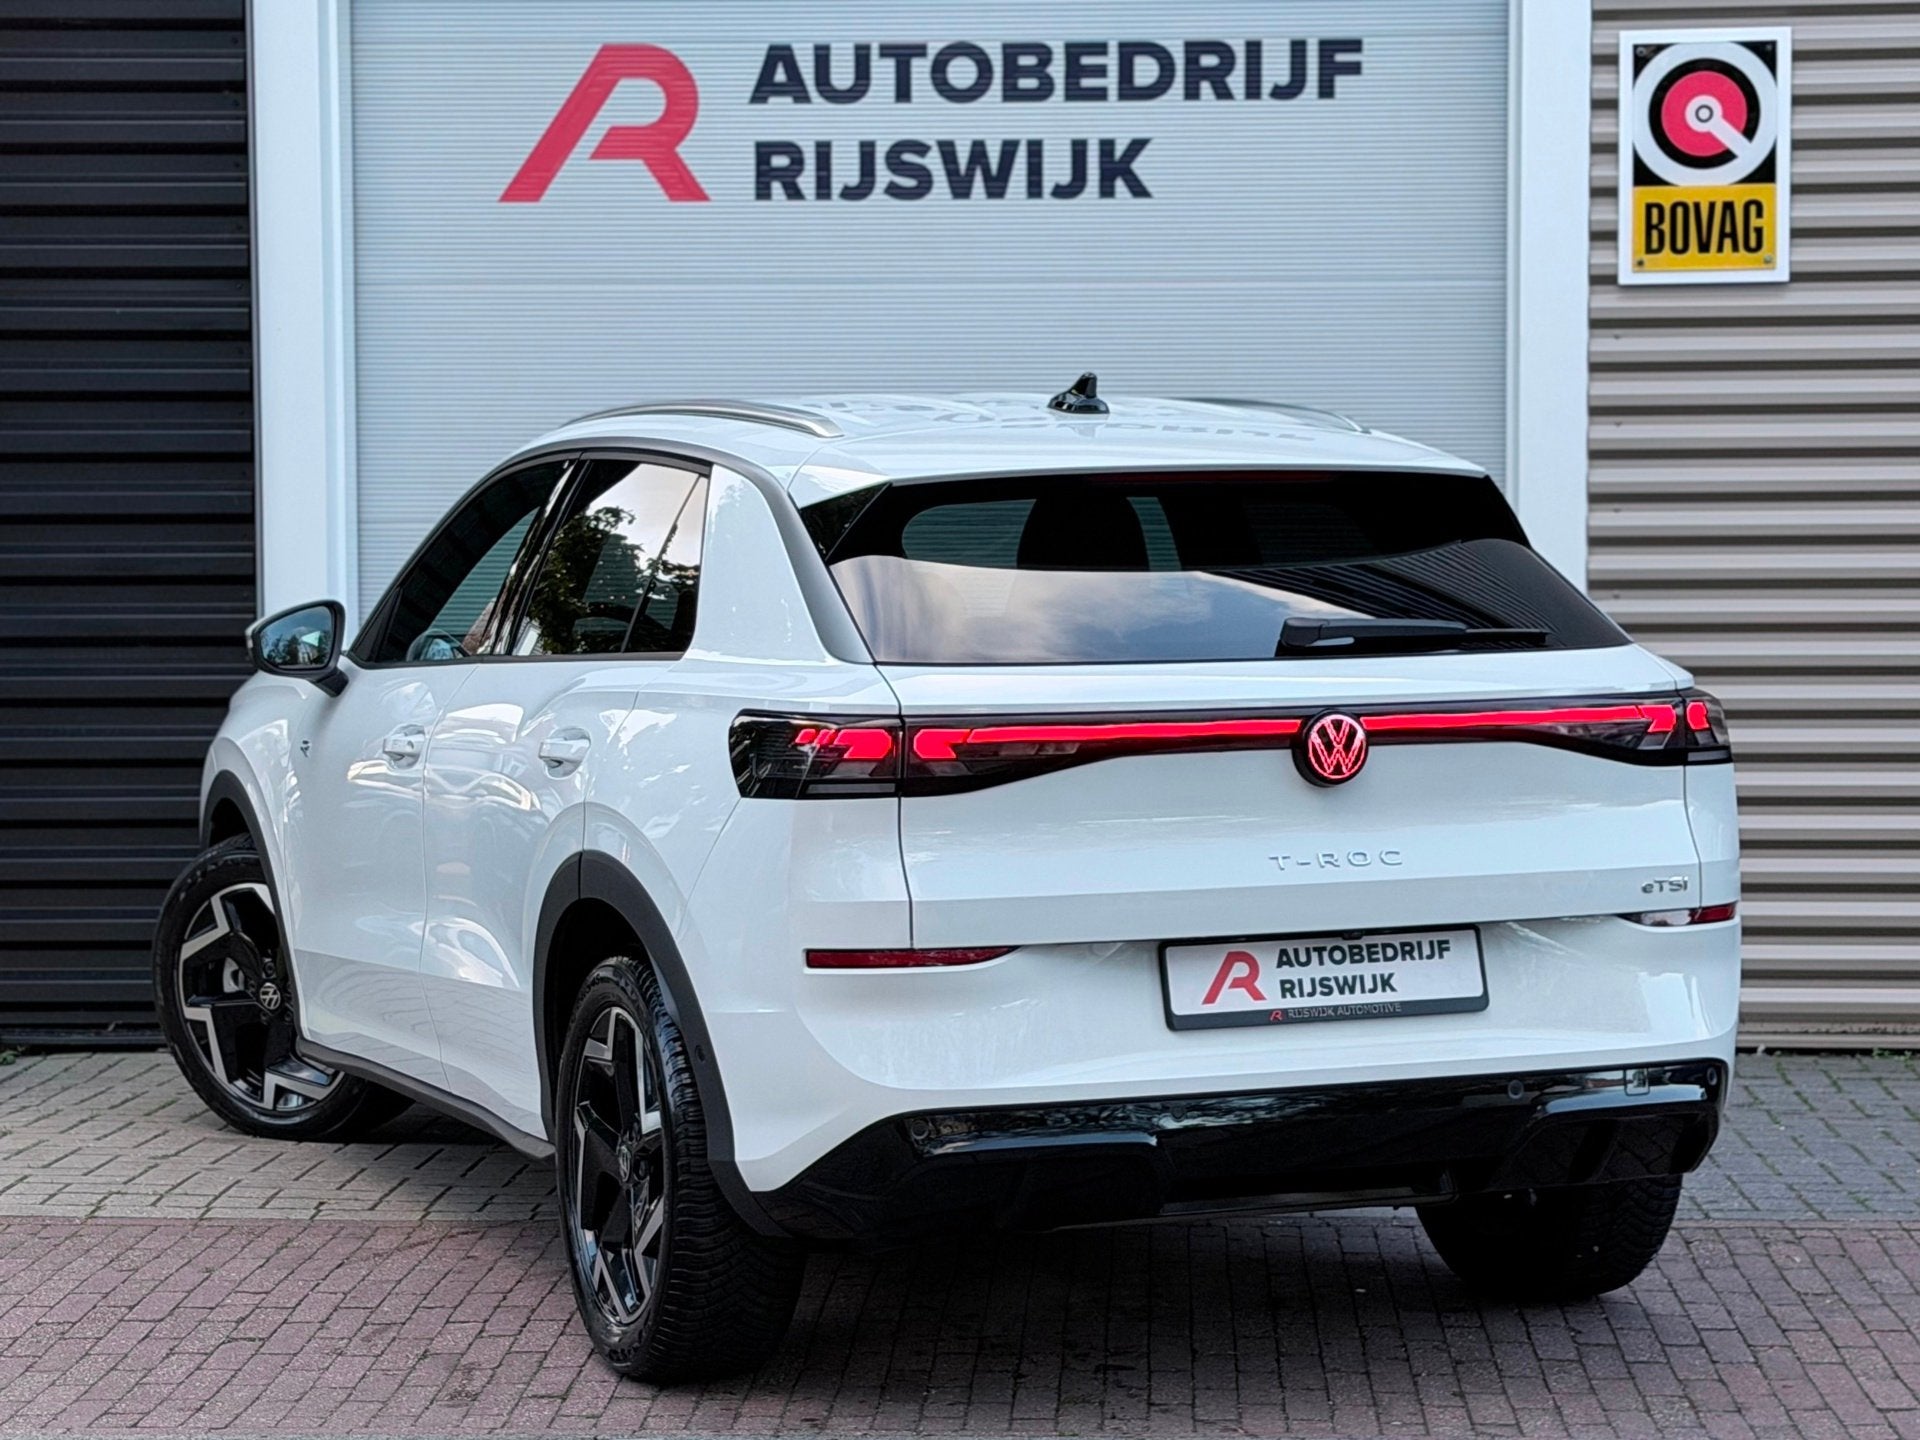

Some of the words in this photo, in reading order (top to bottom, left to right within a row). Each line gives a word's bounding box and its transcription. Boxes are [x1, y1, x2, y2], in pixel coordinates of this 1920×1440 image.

[748, 38, 1364, 104] AUTOBEDRIJF
[753, 137, 1154, 201] RIJSWIJK
[1644, 199, 1764, 256] BOVAG
[1268, 850, 1403, 871] T-ROC
[1275, 939, 1451, 969] AUTOBEDRIJF
[1279, 972, 1398, 999] RIJSWIJK
[1287, 1005, 1335, 1019] RIJSWIJK
[1337, 1002, 1402, 1016] AUTOMOTIVE
